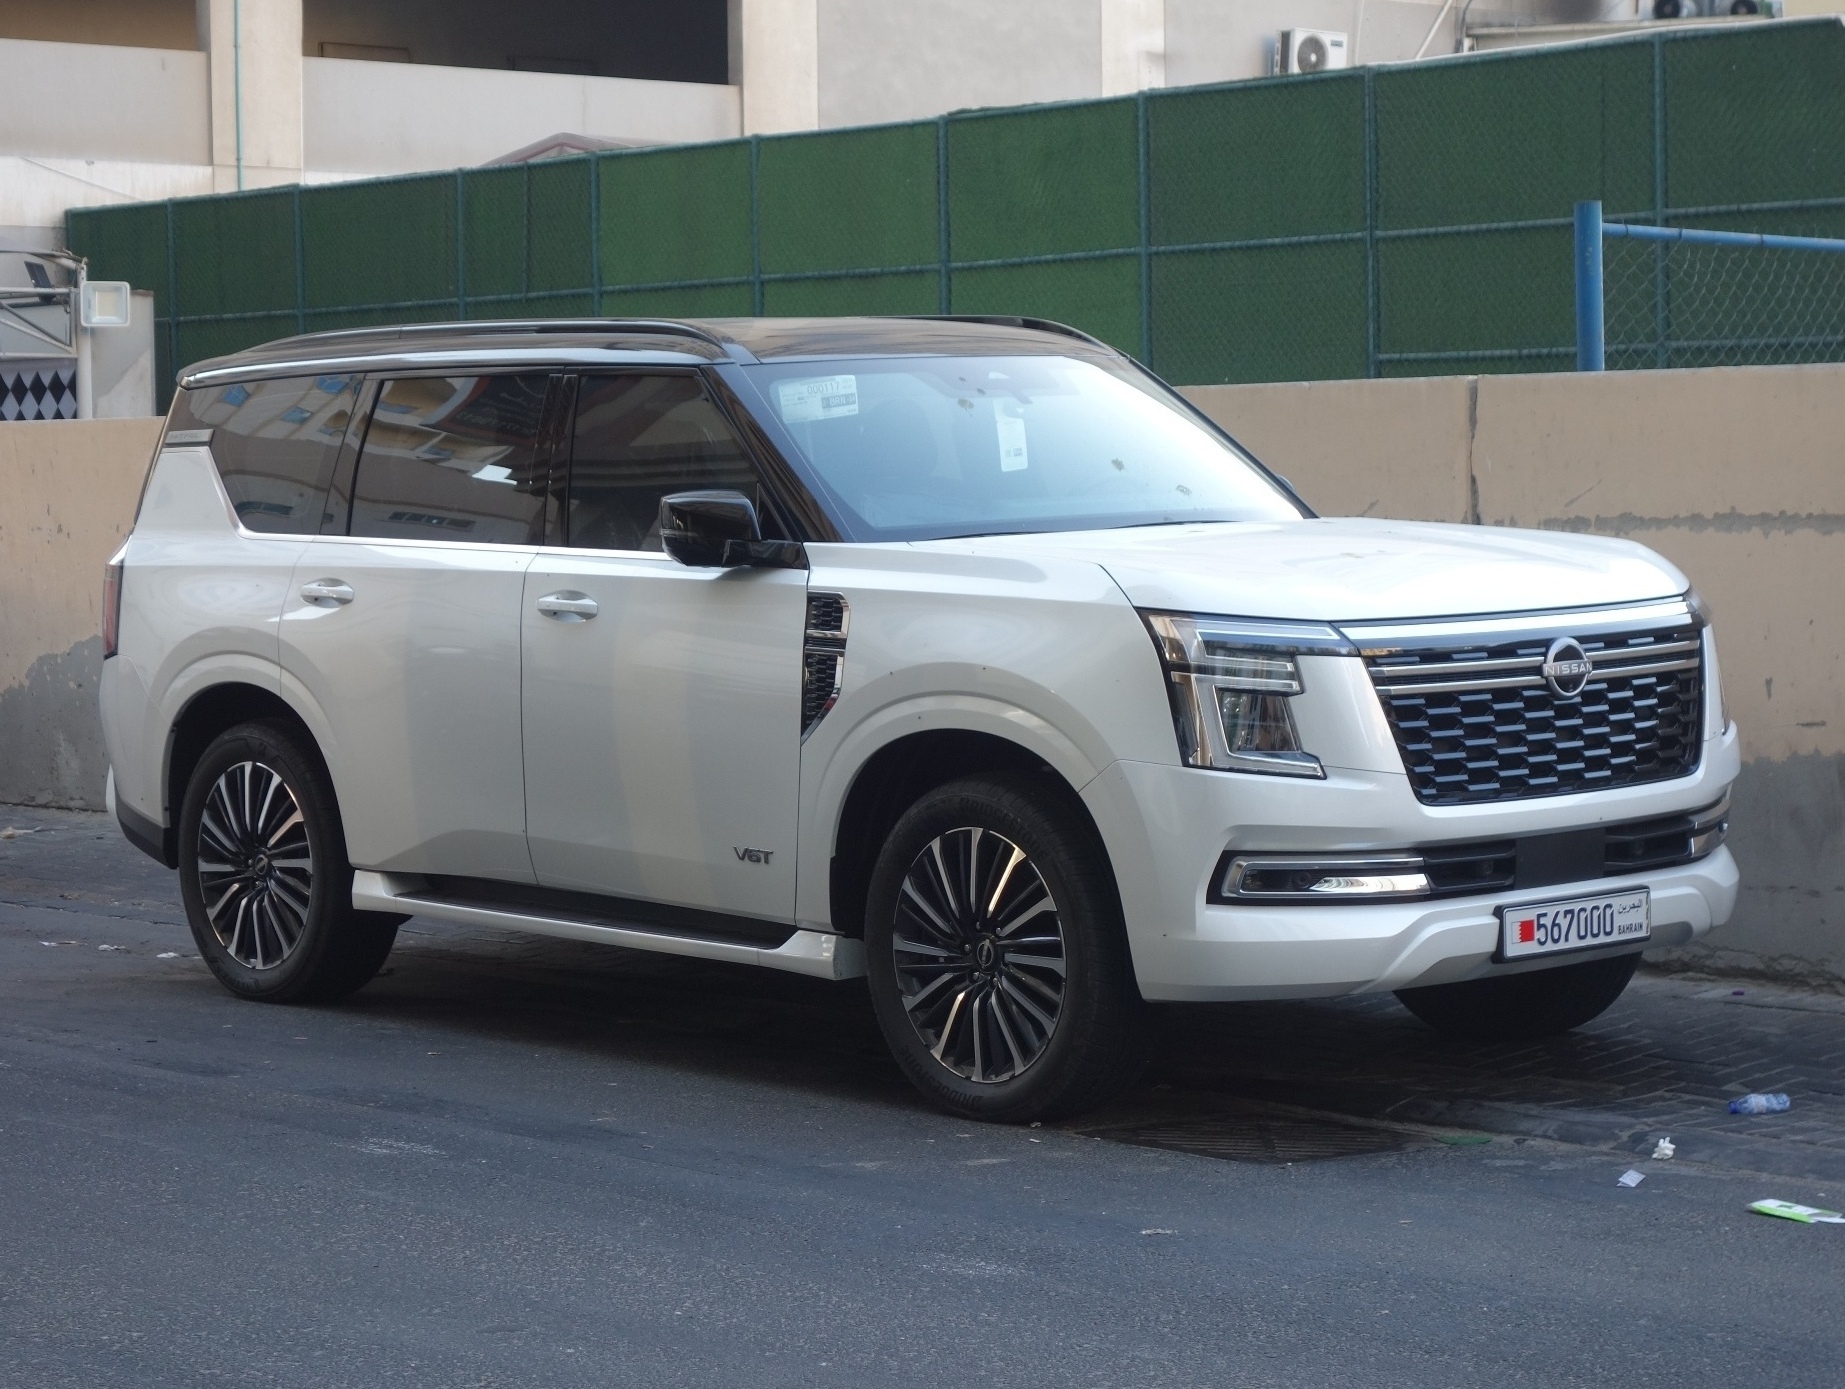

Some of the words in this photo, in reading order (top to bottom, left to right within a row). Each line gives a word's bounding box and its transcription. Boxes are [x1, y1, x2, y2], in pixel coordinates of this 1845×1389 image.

[1545, 662, 1592, 675] NISSAN
[1617, 898, 1643, 914] البحرين
[1536, 903, 1614, 946] 567000
[1618, 922, 1643, 935] BAHRAIN
